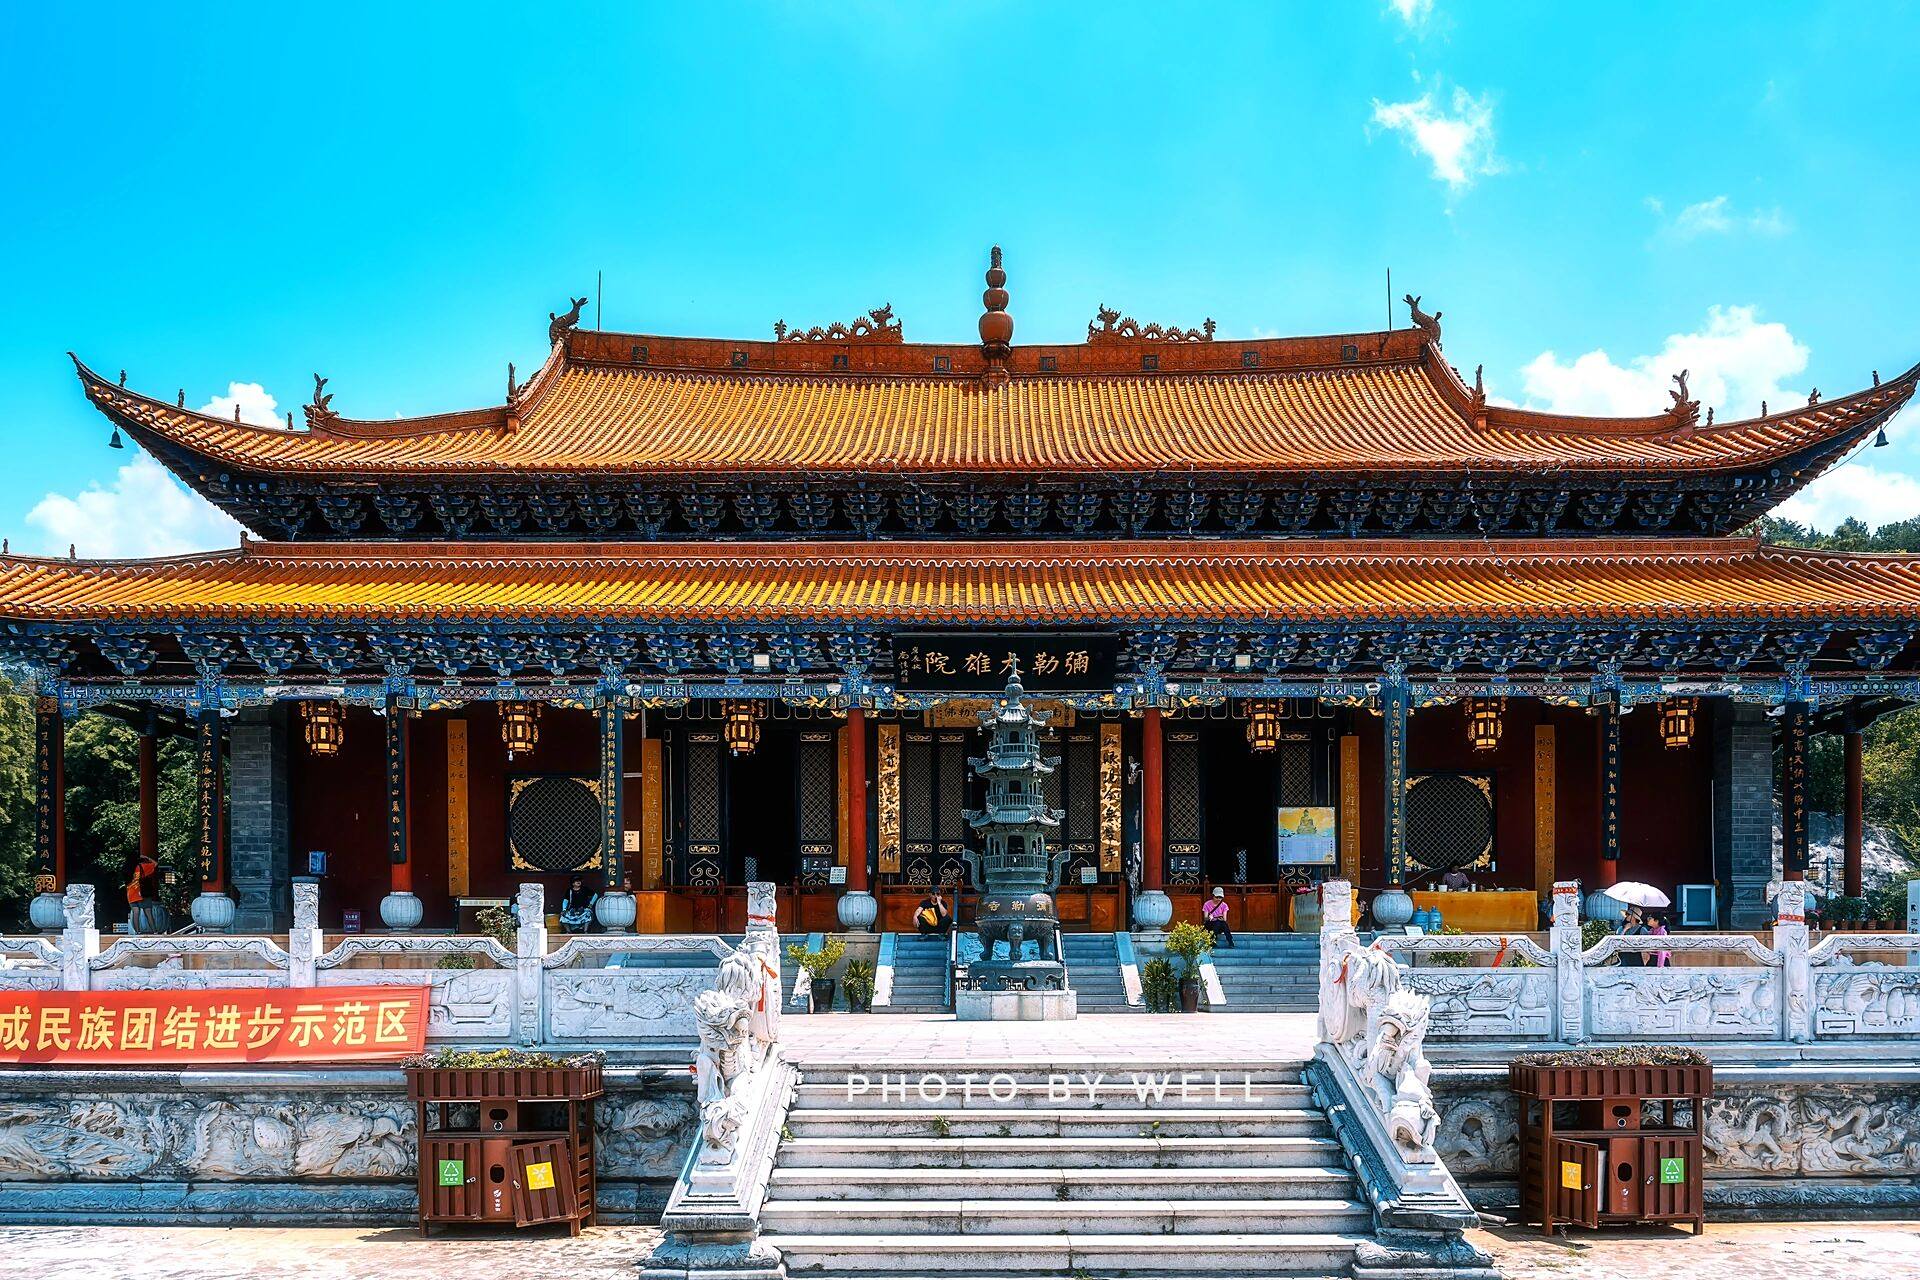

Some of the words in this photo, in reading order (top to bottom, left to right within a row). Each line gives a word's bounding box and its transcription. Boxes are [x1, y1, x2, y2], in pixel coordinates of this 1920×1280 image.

[925, 650, 1089, 677] 彌勒大雄院
[0, 1001, 412, 1052] 成民族团结进步示范区
